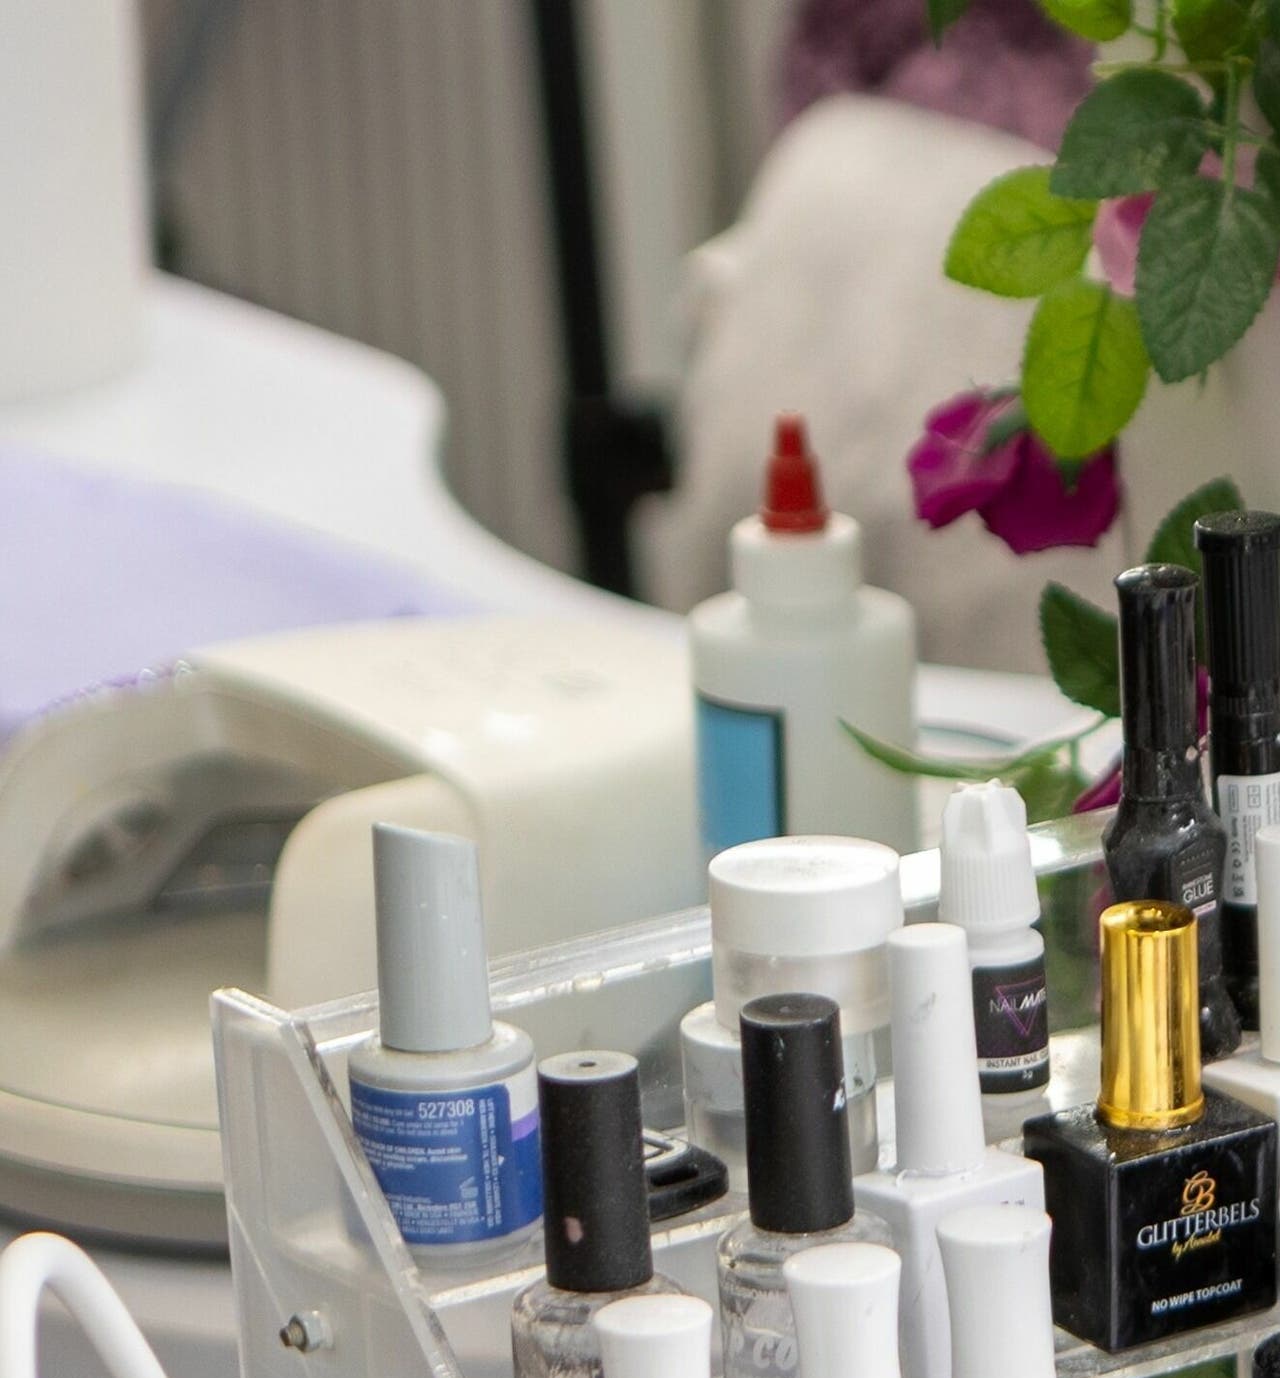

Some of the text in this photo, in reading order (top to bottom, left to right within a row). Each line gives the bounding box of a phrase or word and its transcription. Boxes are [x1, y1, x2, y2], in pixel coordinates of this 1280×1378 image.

[1182, 879, 1215, 904] GLUE
[417, 1098, 476, 1120] 527308
[1136, 1197, 1260, 1248] GLITTERBELS
[1150, 1278, 1243, 1313] NO WIPE TOPCOAT
